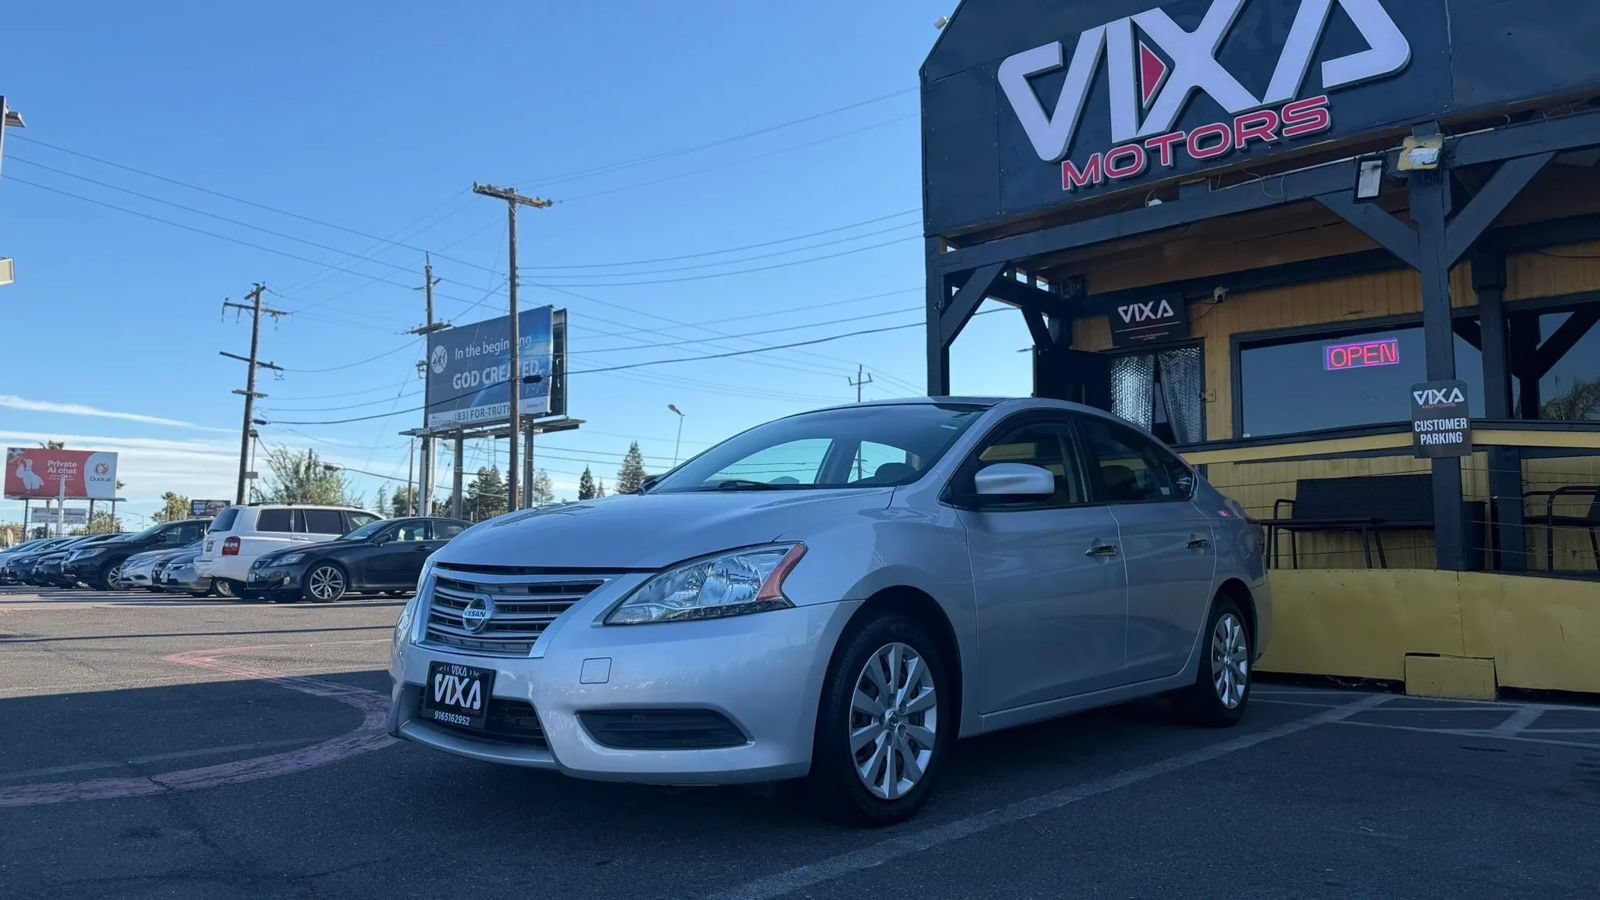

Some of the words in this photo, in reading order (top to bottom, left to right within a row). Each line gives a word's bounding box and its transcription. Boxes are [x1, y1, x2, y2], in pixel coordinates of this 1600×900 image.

[998, 0, 1412, 162] VIXA
[1062, 94, 1332, 190] MOTORS
[1117, 299, 1174, 324] VIXA
[455, 347, 464, 360] In
[465, 343, 481, 357] the
[483, 336, 532, 355] beginng
[1330, 343, 1397, 367] OPEN
[453, 370, 479, 390] GOD
[1413, 387, 1465, 406] VIXA
[1414, 418, 1467, 432] CUSTOMER
[1420, 432, 1463, 445] PARKING
[48, 460, 77, 468] Private
[57, 467, 77, 475] chat
[434, 673, 481, 710] VIXA
[434, 710, 471, 726] 9165162952
